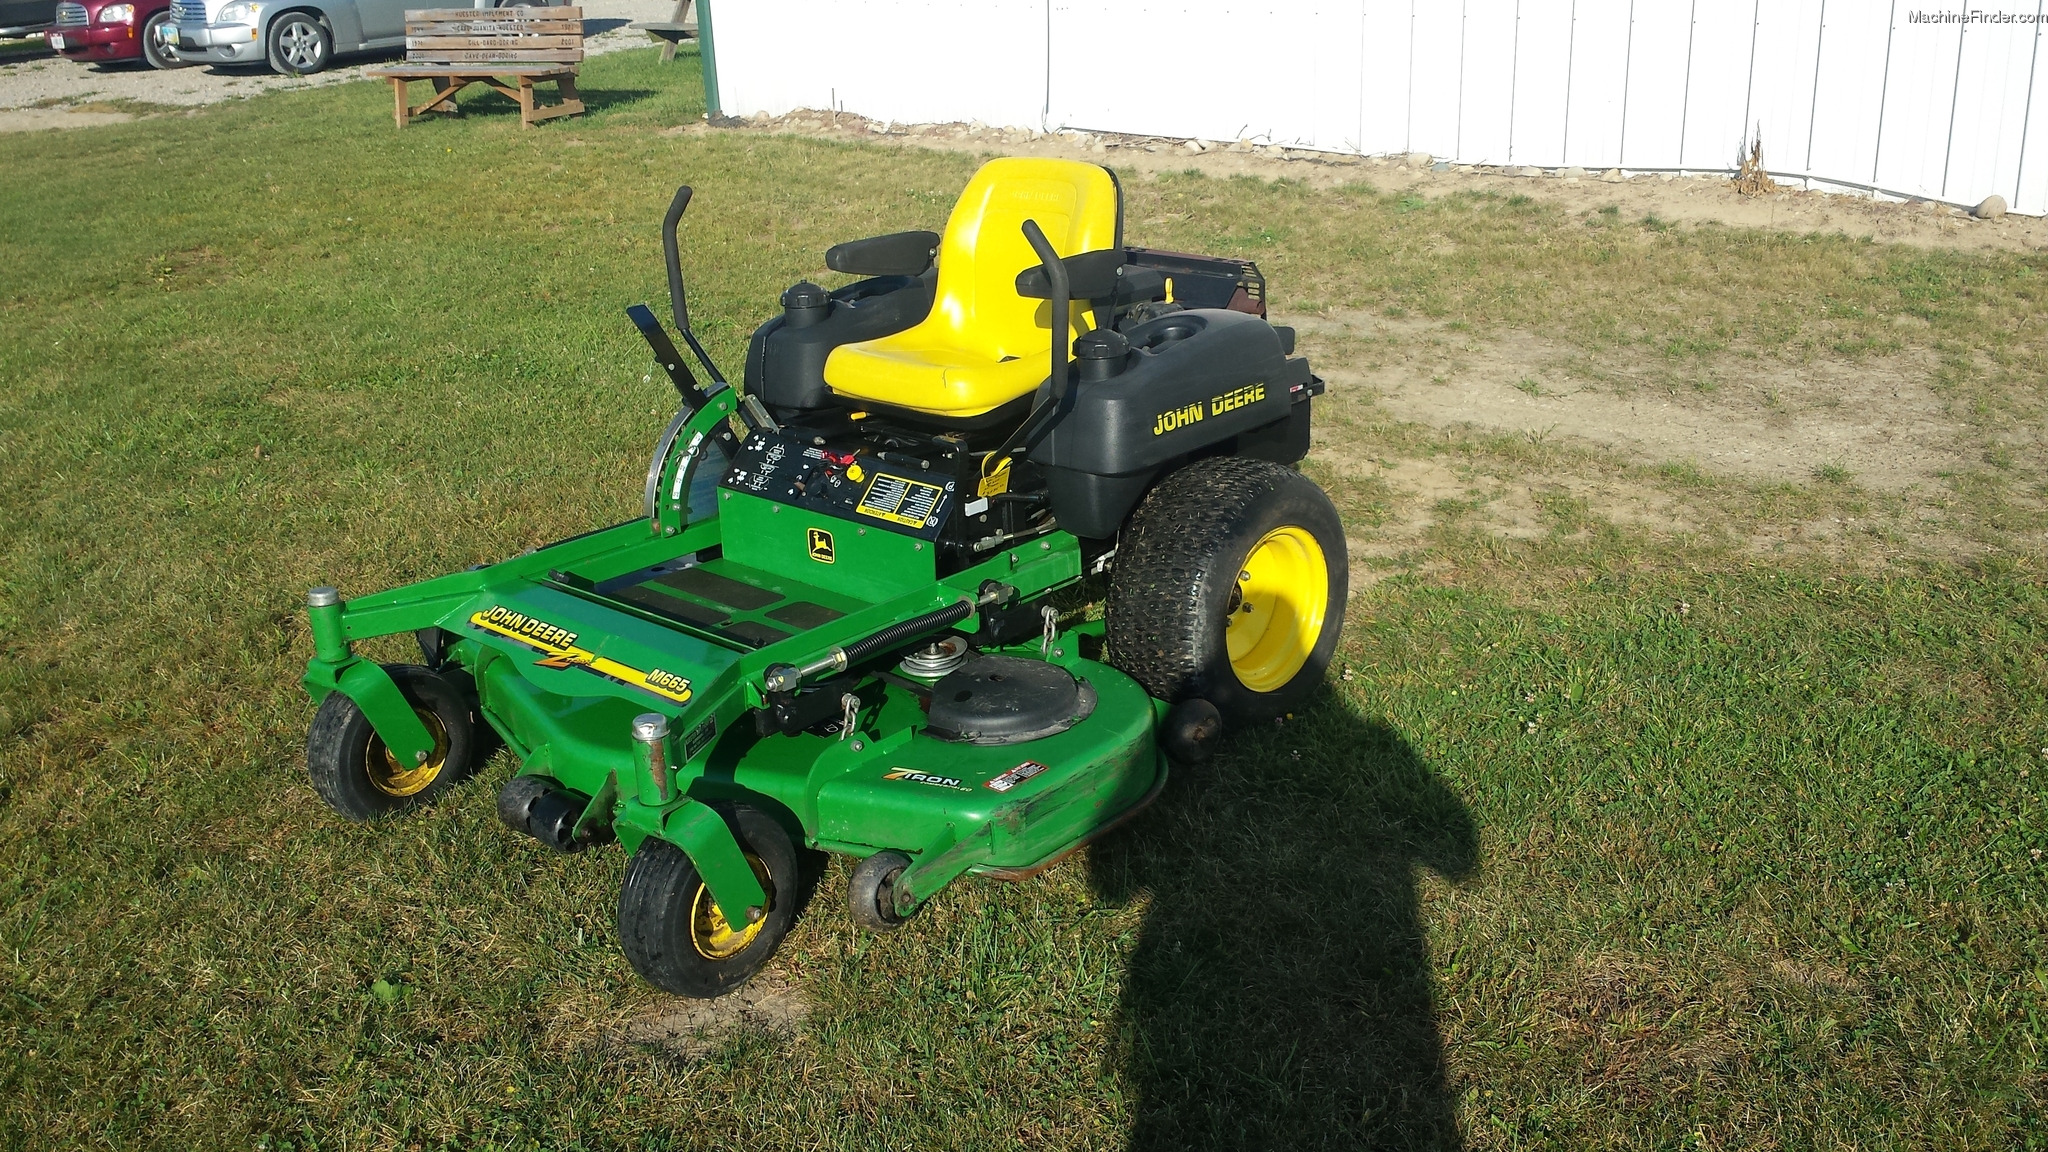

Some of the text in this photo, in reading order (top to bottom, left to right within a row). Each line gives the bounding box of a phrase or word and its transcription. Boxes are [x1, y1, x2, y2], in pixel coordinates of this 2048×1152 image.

[481, 10, 513, 18] IMPLEMENT
[1153, 382, 1266, 436] JOHN DEERE
[646, 668, 691, 694] M665
